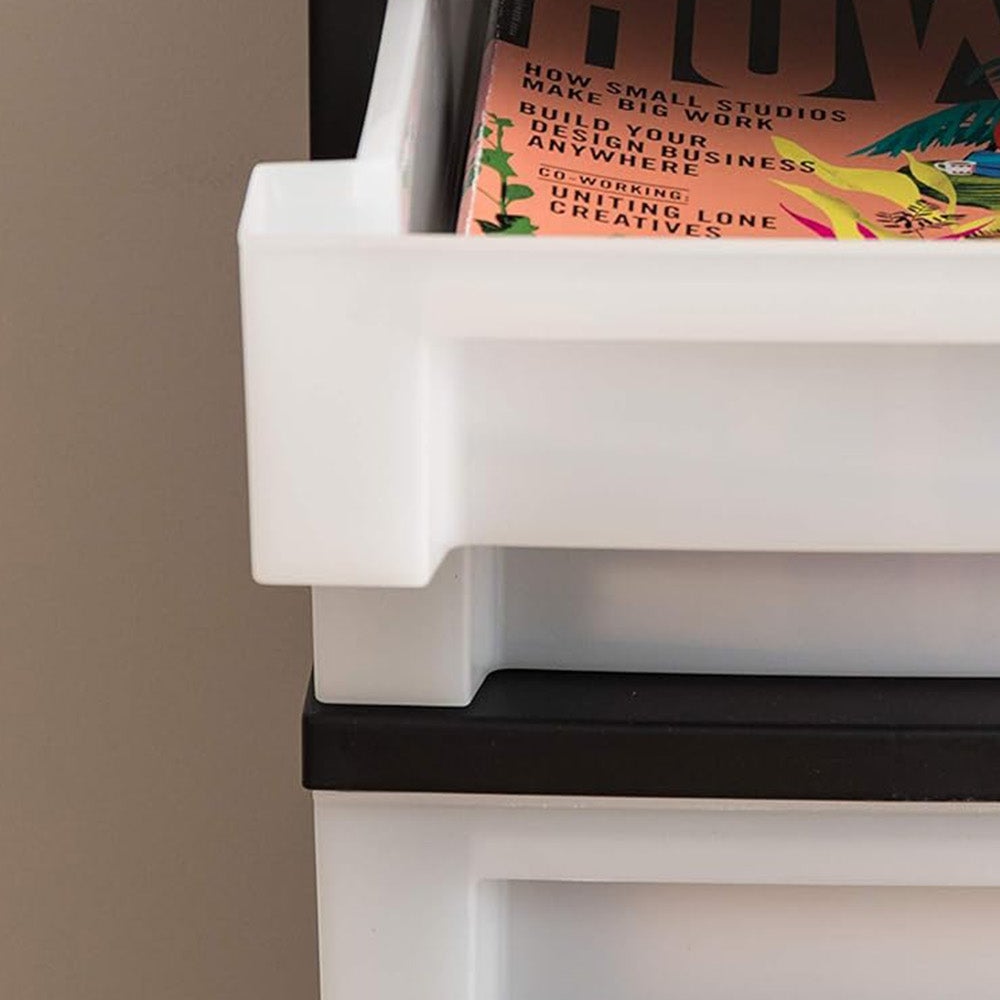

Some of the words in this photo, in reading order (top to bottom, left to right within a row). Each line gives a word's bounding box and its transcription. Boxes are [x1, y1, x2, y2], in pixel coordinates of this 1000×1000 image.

[521, 77, 602, 106] MAKE
[618, 98, 670, 118] BIG
[684, 108, 774, 131] WORK
[524, 61, 592, 89] HOW
[606, 80, 702, 109] SMALL
[717, 99, 848, 123] STUDIOS
[519, 100, 610, 132] BUILD
[626, 124, 709, 148] YOUR
[530, 118, 645, 154] DESIGN
[661, 145, 817, 174] BUSINESS
[527, 134, 701, 177] ANYWHERE
[550, 200, 723, 238] CREATIVES
[551, 185, 681, 219] UNITING
[697, 210, 778, 230] LONE
